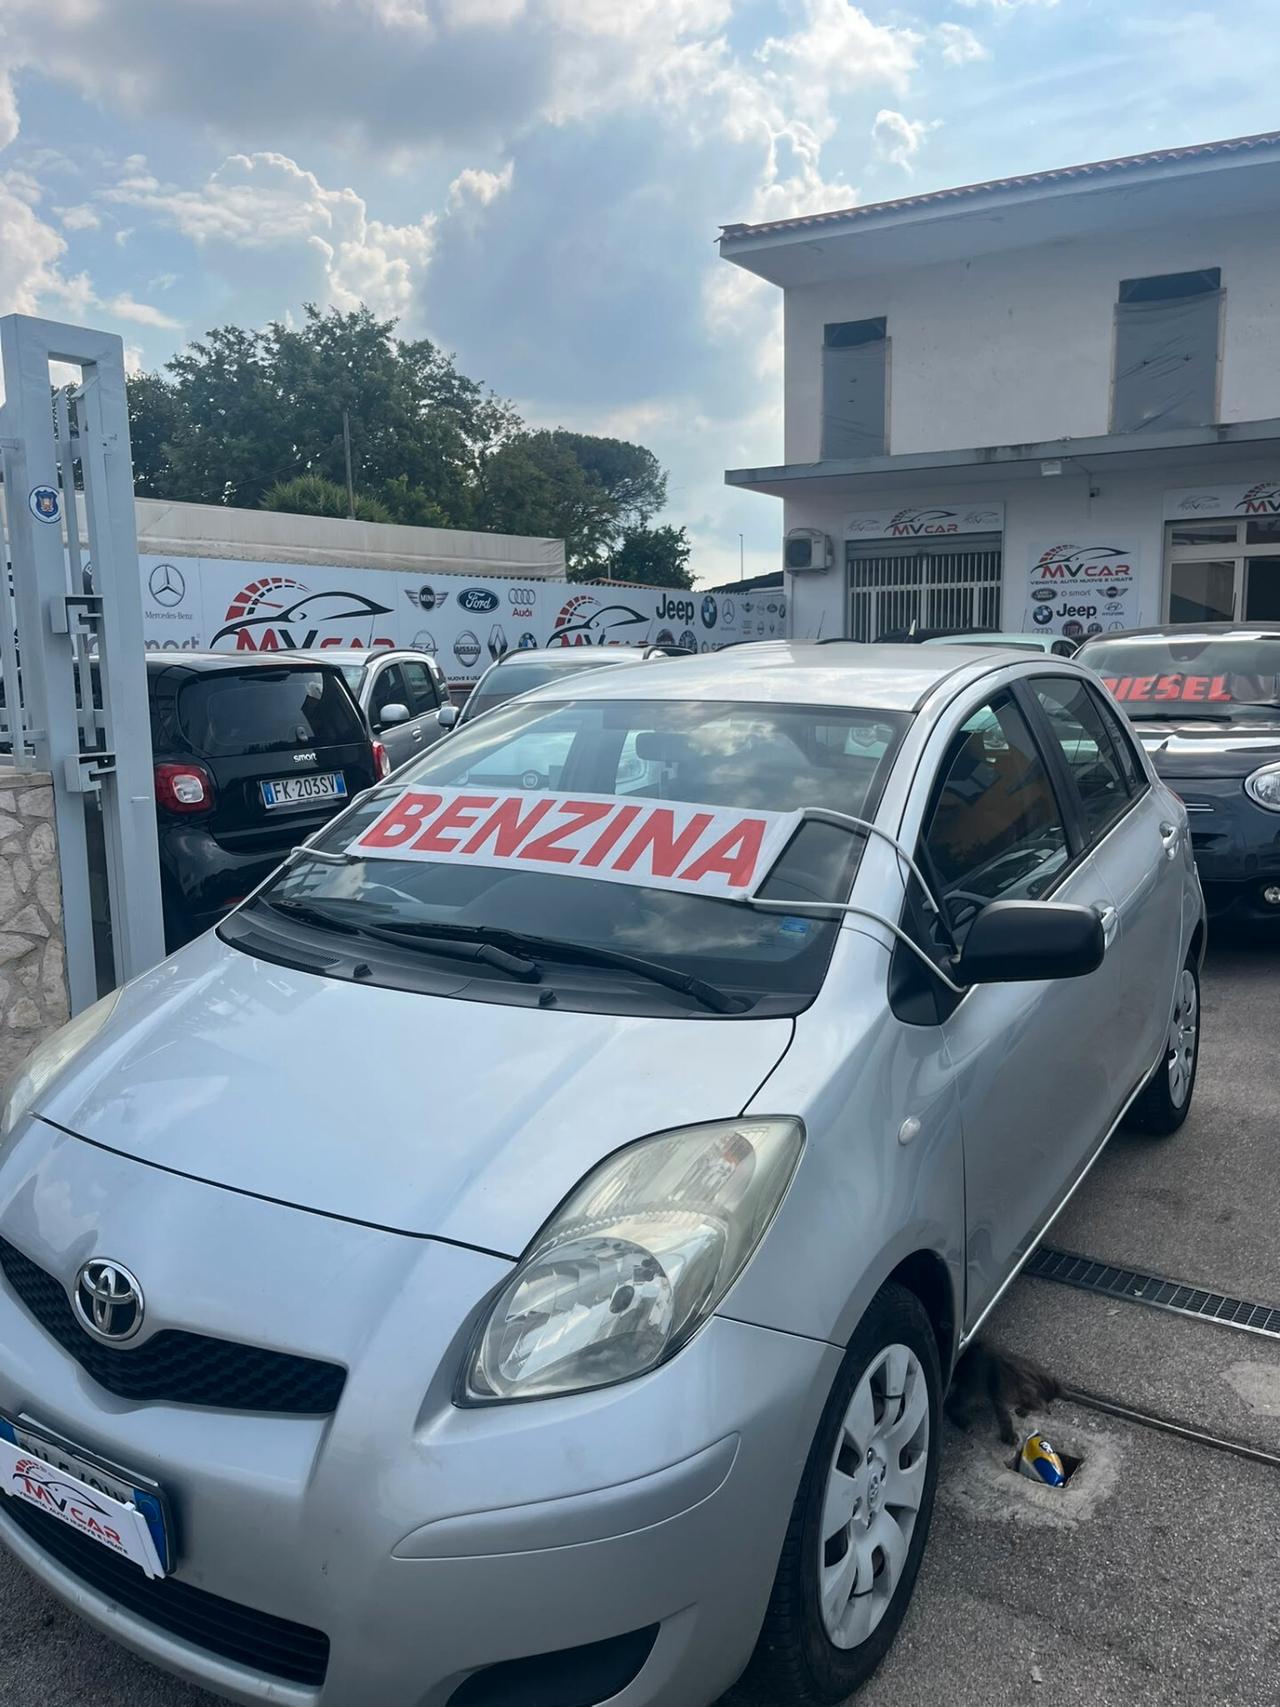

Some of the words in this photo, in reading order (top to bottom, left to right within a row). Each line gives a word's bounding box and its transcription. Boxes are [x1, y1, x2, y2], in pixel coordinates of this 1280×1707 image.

[465, 591, 492, 609] Ford
[656, 593, 694, 625] Jeep
[512, 607, 533, 617] Audi
[1056, 603, 1097, 619] Jeep
[358, 792, 767, 888] BENZINA
